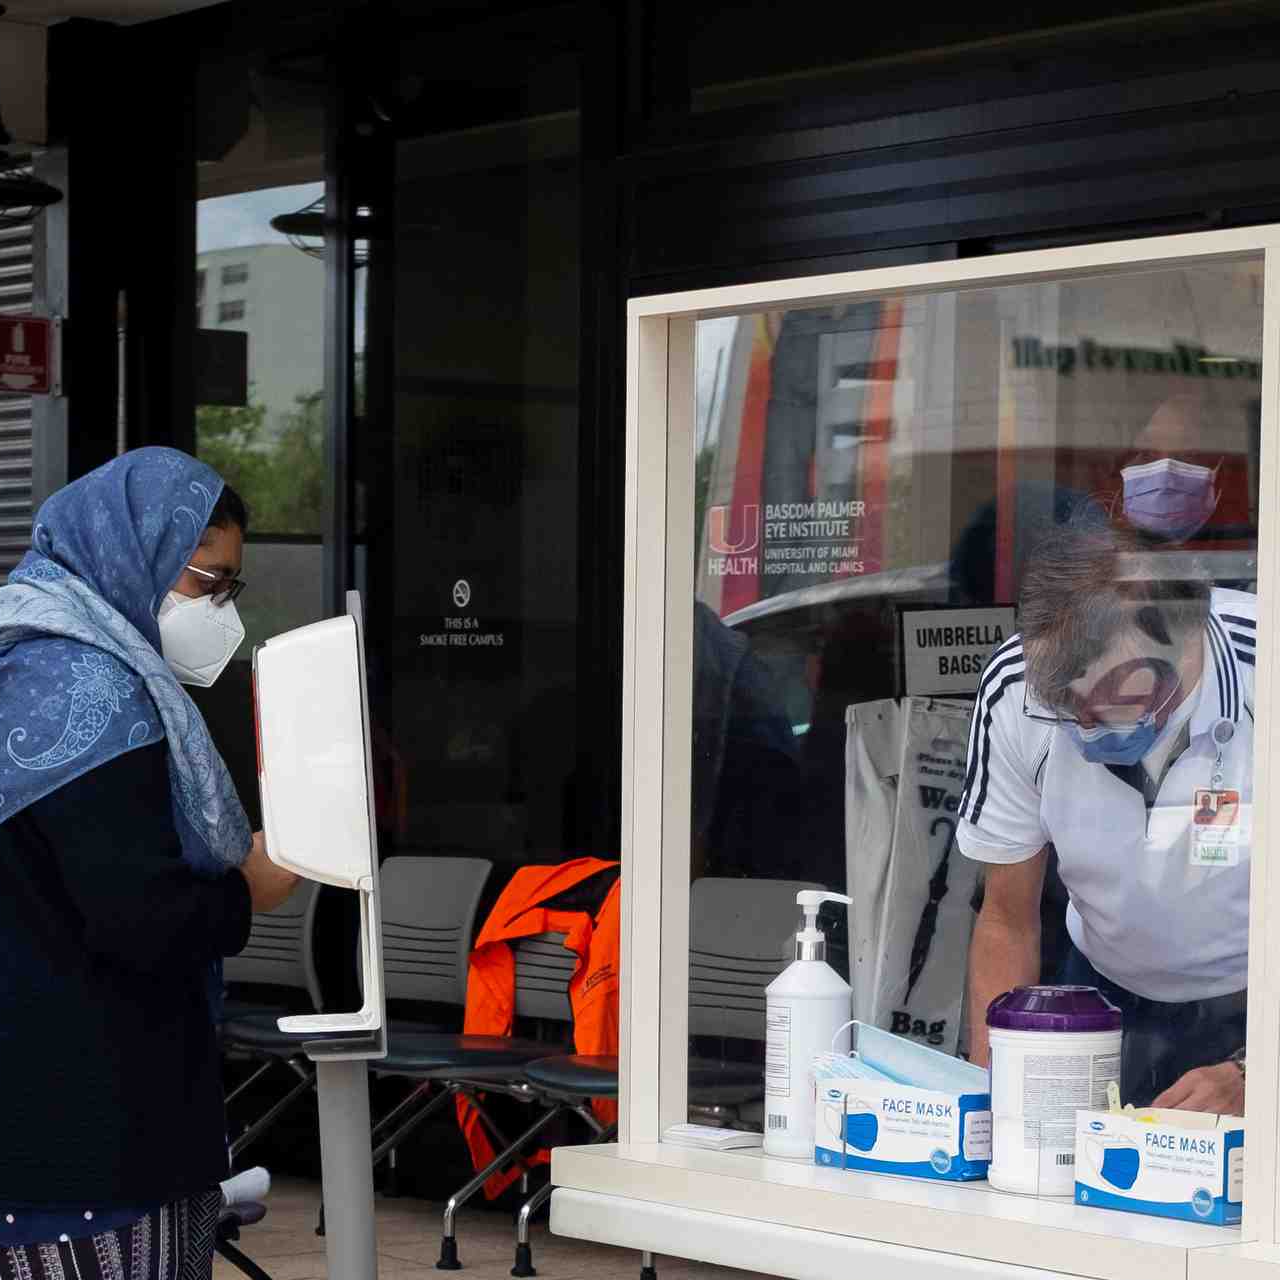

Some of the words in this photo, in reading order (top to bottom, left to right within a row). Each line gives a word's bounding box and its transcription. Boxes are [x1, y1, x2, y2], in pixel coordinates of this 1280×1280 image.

[765, 503, 815, 520] BASCOM
[817, 501, 865, 518] PALMER
[709, 504, 760, 555] U
[765, 522, 787, 539] EYE
[789, 520, 850, 538] INSTITUTE
[764, 548, 817, 561] UNIVERSITY
[818, 547, 829, 559] OF
[831, 545, 859, 557] MIAMI
[708, 557, 759, 577] HEALTH
[764, 562, 808, 575] HOSPITAL
[808, 561, 828, 573] AND
[829, 560, 865, 573] CLINICS
[444, 617, 463, 630] THIS
[464, 617, 472, 629] IS
[472, 617, 480, 629] A
[420, 633, 448, 646] SMOKE
[449, 633, 468, 646] FREE
[469, 633, 504, 646] CAMPUS
[916, 625, 1004, 648] UMBRELLA
[938, 654, 982, 676] BAGS
[891, 1010, 947, 1046] Bag
[882, 1098, 913, 1114] FACE
[915, 1102, 954, 1118] MASK
[1145, 1132, 1176, 1149] FACE
[1179, 1137, 1217, 1155] MASK
